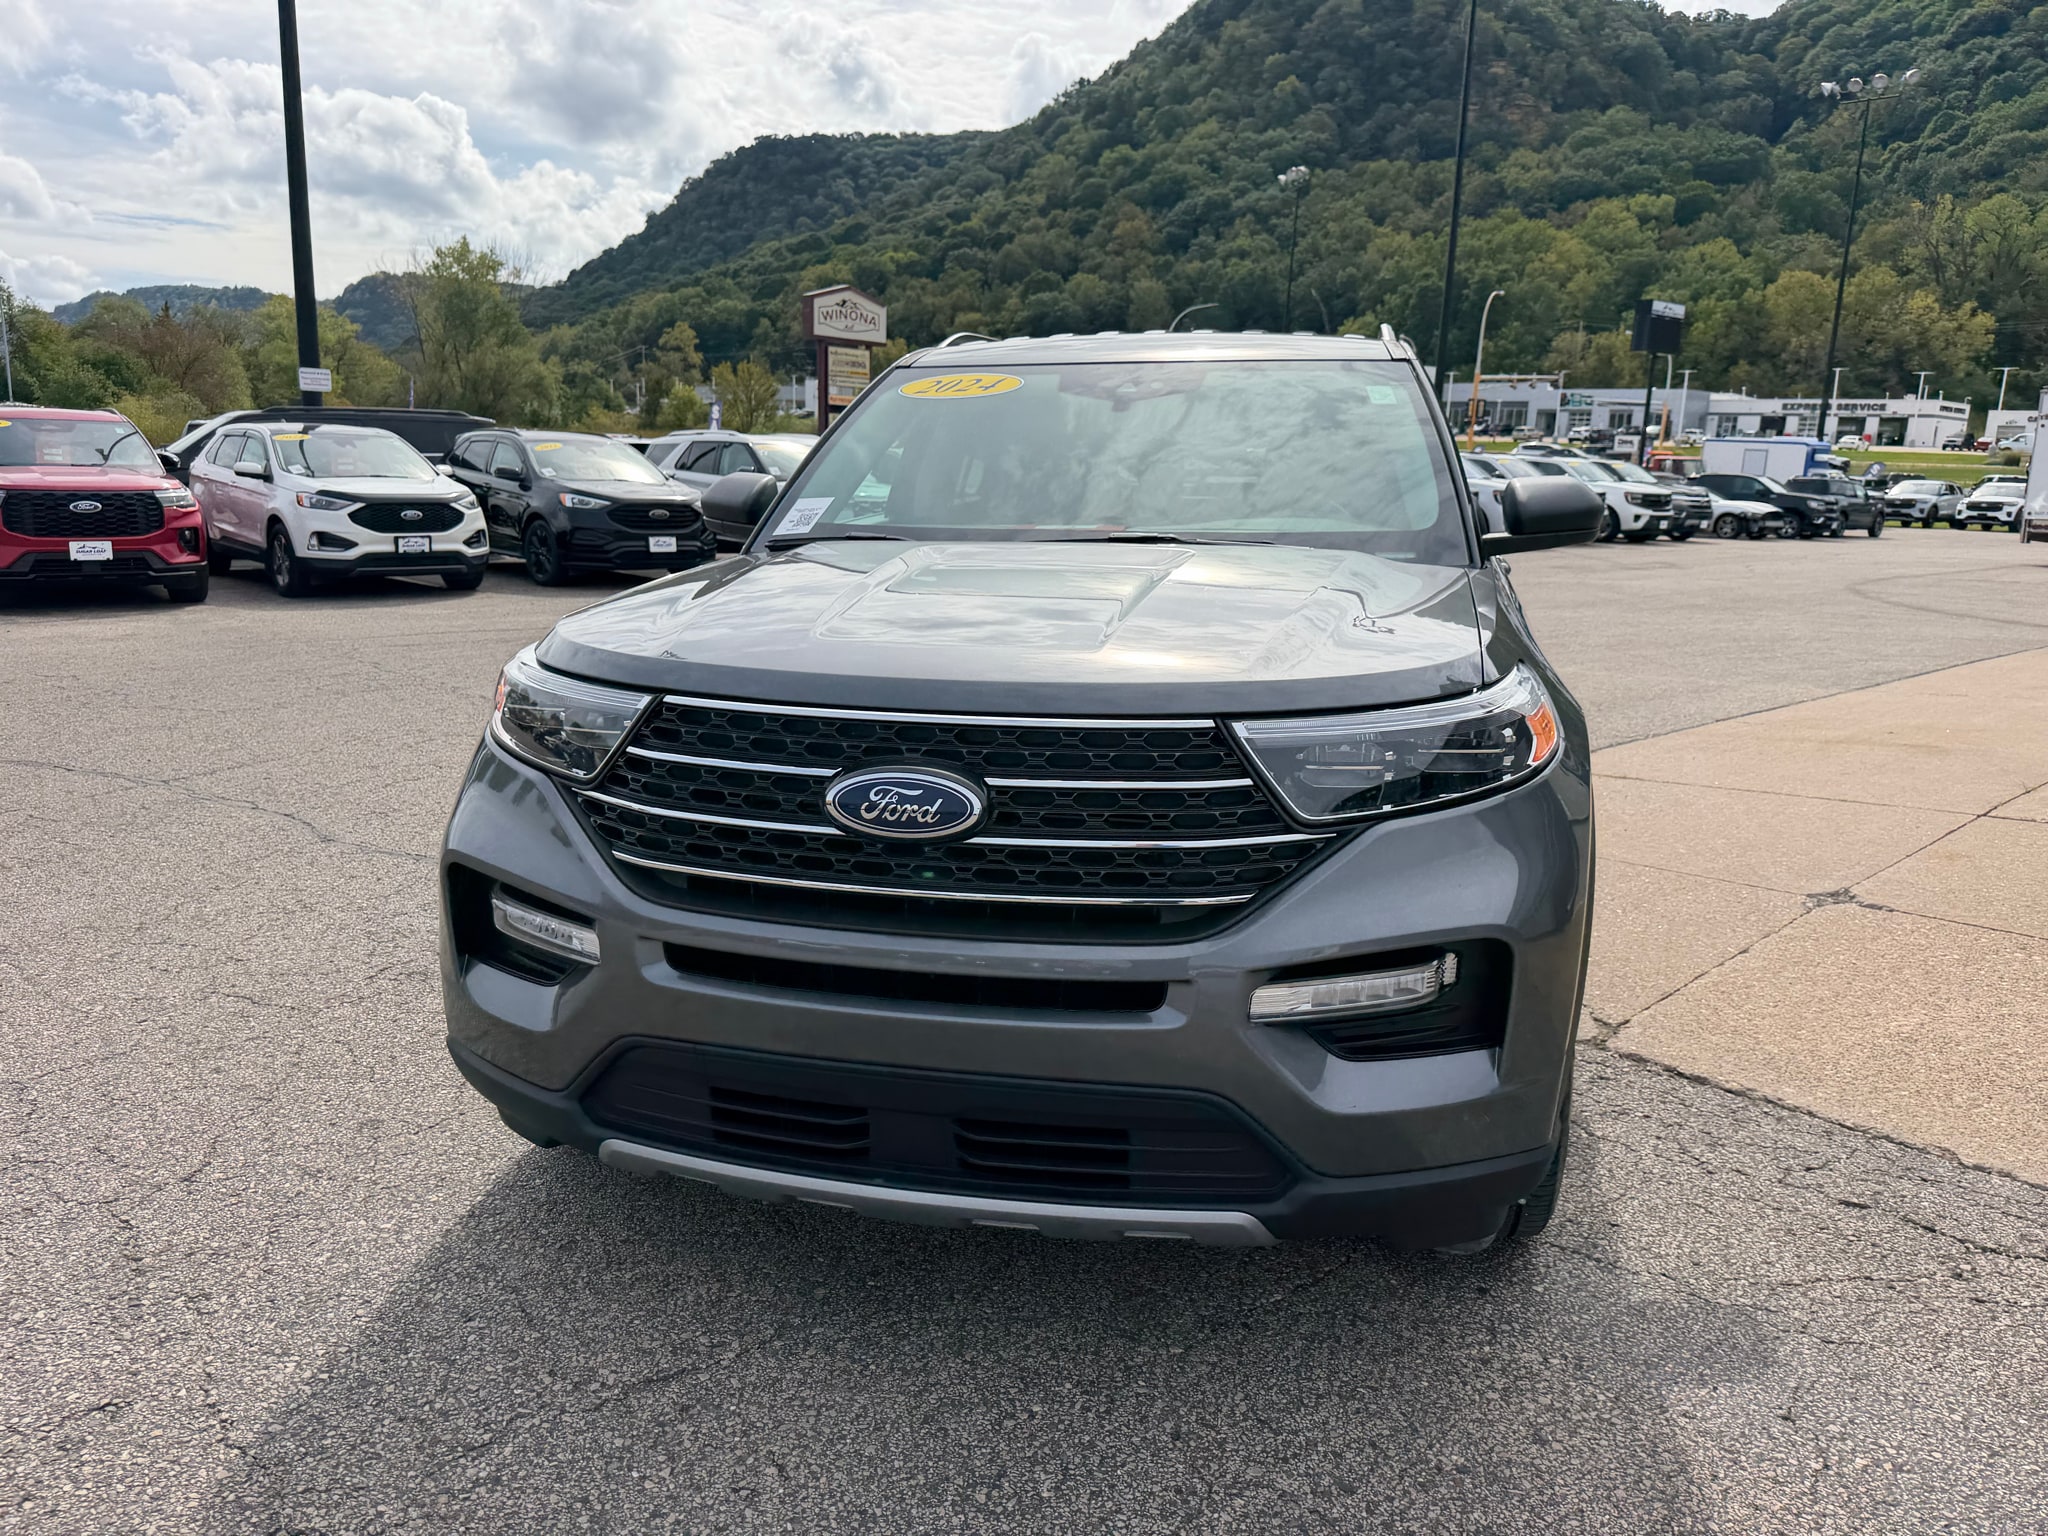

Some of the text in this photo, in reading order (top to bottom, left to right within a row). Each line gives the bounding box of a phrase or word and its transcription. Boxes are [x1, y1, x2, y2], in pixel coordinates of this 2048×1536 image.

[821, 309, 877, 328] WINONA
[913, 377, 1009, 394] 2024
[1837, 403, 1887, 411] SERVICE
[860, 785, 943, 823] Ford
